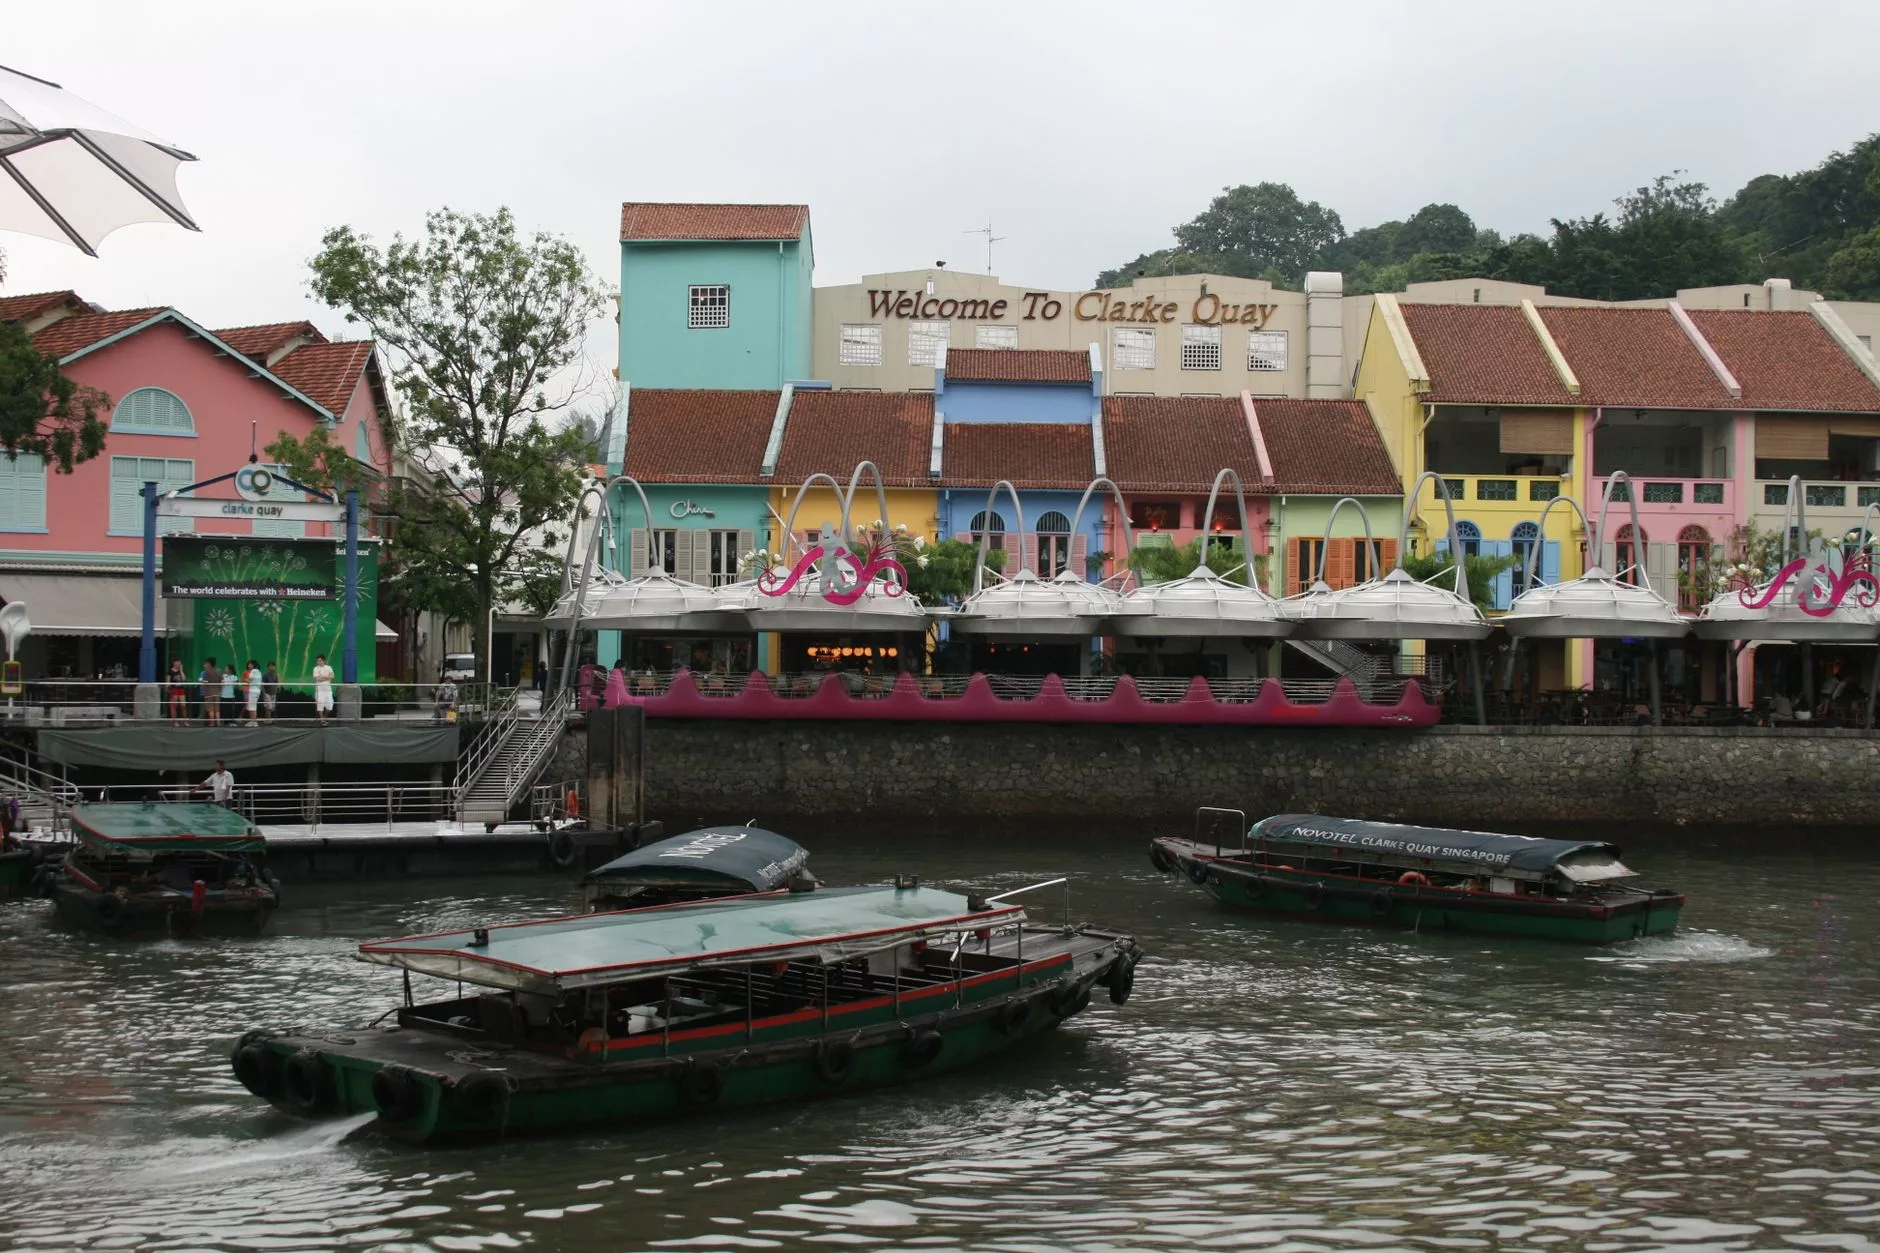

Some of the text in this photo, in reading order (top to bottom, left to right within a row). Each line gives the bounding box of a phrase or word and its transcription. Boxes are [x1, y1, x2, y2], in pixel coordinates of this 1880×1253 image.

[867, 289, 1278, 332] Welcome To Clarke Quay
[222, 502, 283, 518] clarke quay
[172, 586, 326, 597] The world celebrates with Heineken
[1291, 827, 1511, 864] NOVOTEL CLARKE QUAY SINGAPORE
